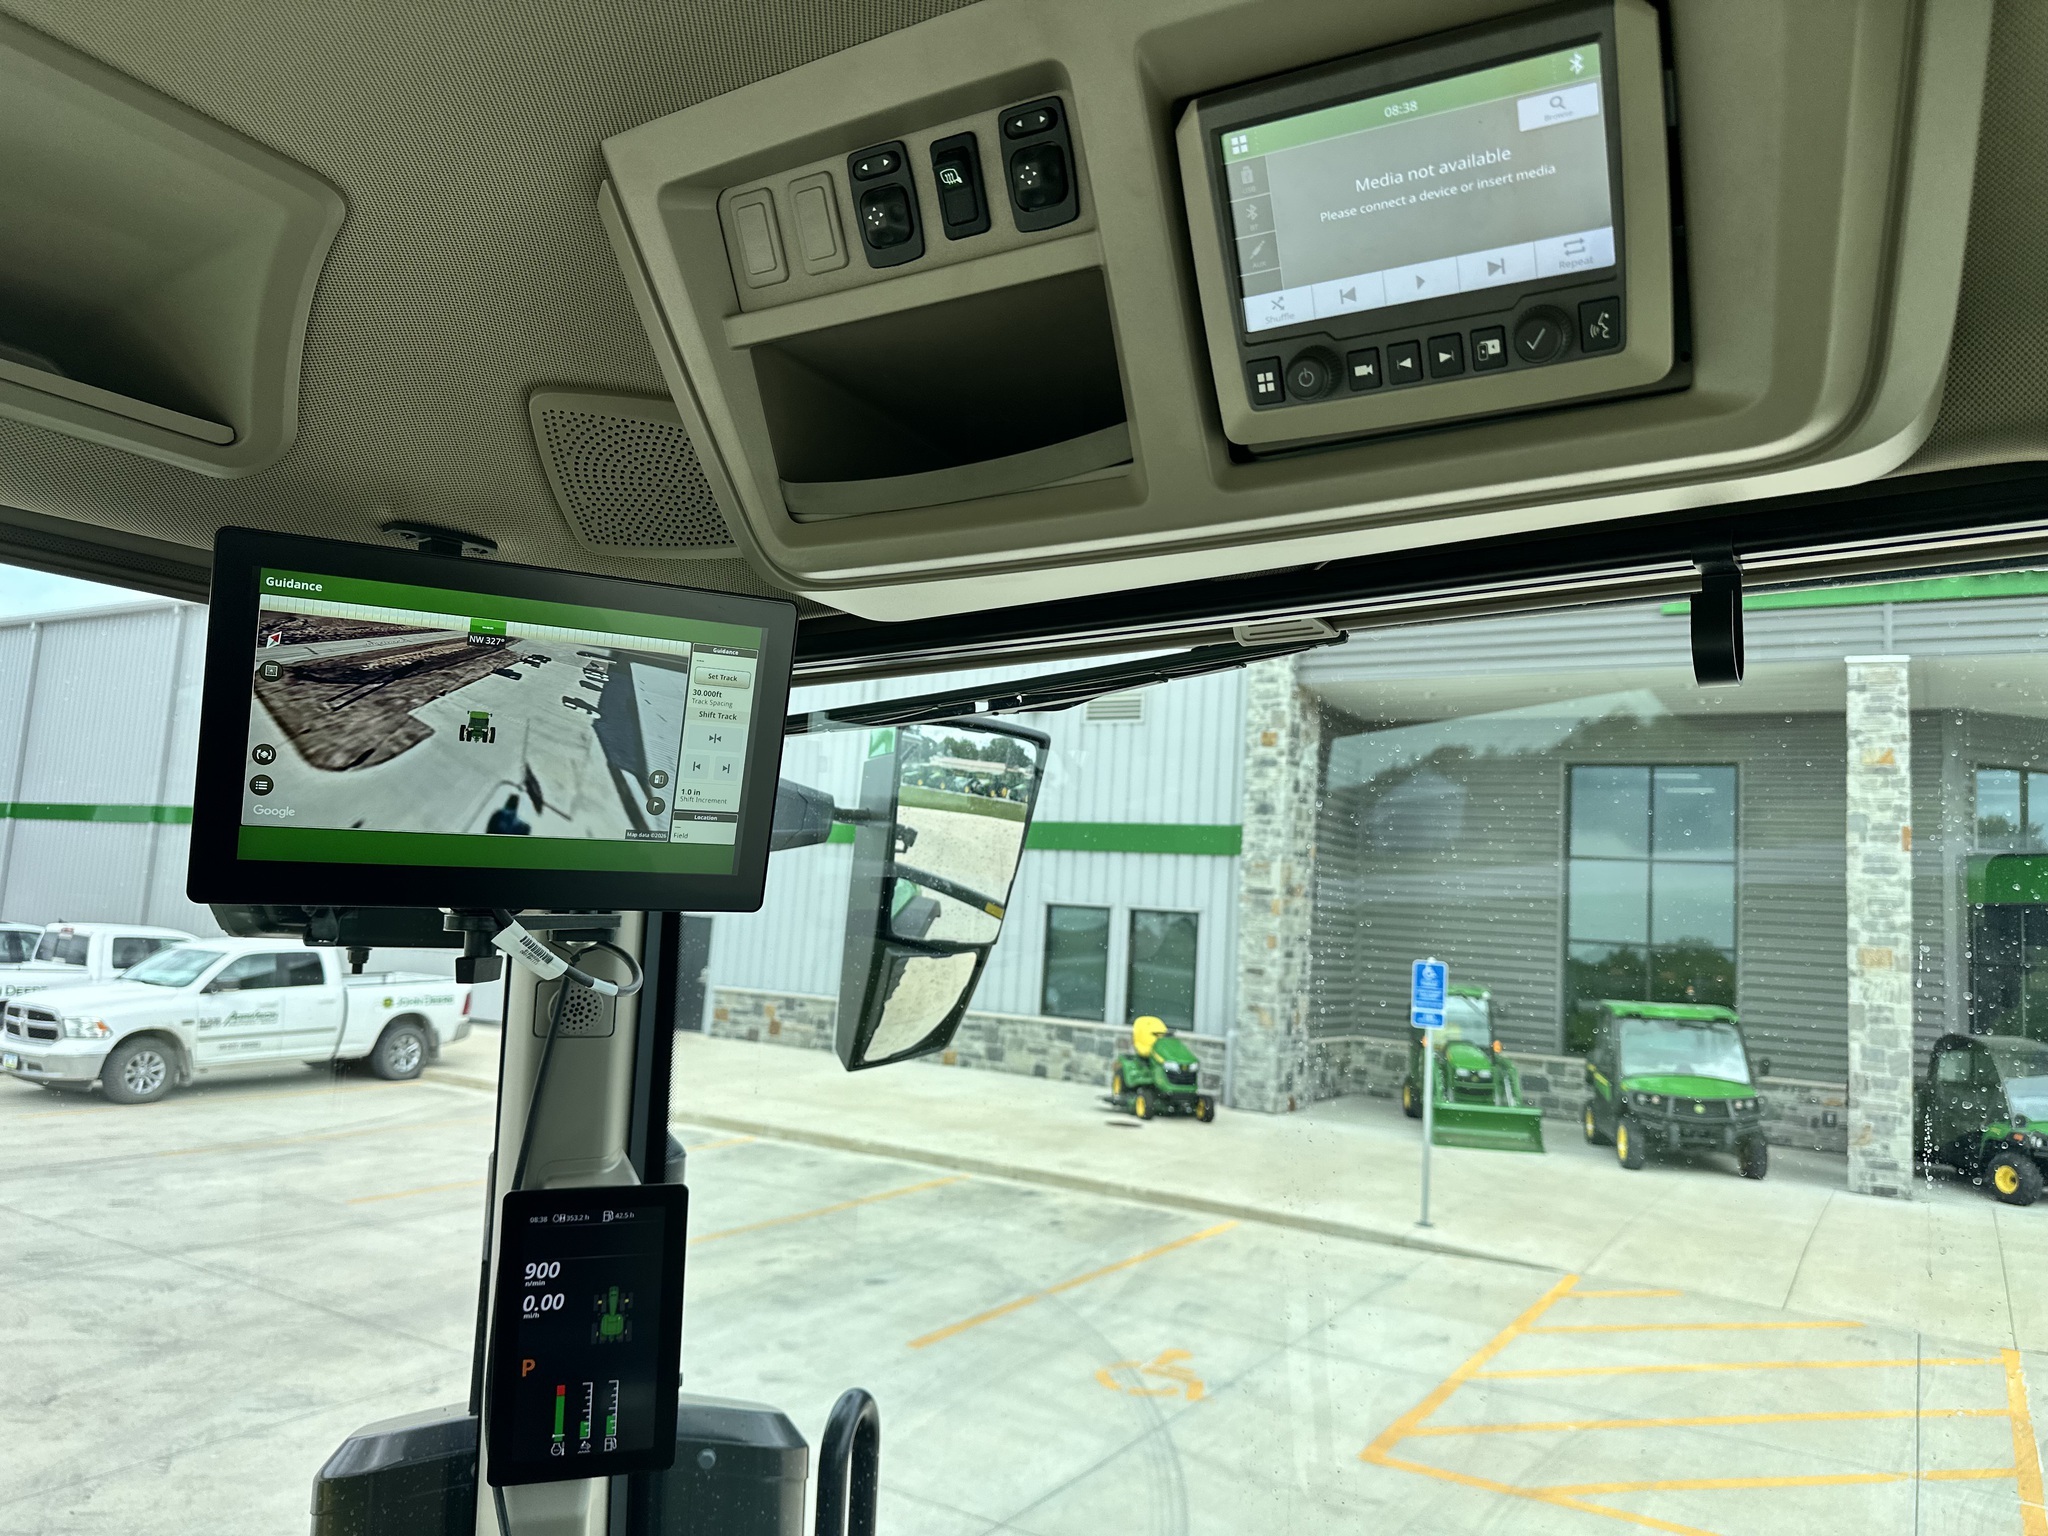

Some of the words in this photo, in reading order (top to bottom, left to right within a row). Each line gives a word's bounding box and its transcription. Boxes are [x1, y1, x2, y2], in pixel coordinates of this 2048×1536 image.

[1384, 100, 1418, 118] 08:38
[1355, 172, 1404, 192] Media
[1407, 164, 1435, 181] not
[1438, 147, 1512, 175] available
[1319, 207, 1358, 222] Please
[1359, 196, 1406, 214] connect
[1408, 195, 1417, 204] a
[1419, 189, 1458, 202] device
[1460, 182, 1474, 193] or
[1477, 173, 1513, 190] insert
[1516, 164, 1556, 181] media
[1559, 256, 1593, 269] Repeat
[1265, 311, 1295, 324] Shuffle
[265, 576, 323, 592] Guidance
[469, 635, 485, 644] NW
[485, 636, 506, 646] 327°
[712, 647, 739, 656] Guidance
[708, 672, 719, 680] Set
[720, 674, 738, 682] Track
[692, 688, 722, 698] 30.000ft
[692, 697, 709, 705] Track
[709, 699, 733, 709] Spacing
[699, 710, 716, 719] Shift
[718, 712, 738, 721] Track
[681, 788, 692, 796] 1.0
[693, 788, 701, 796] in
[680, 796, 695, 804] Shift
[695, 796, 728, 805] Increment
[253, 804, 296, 818] Google
[626, 831, 638, 839] Map
[614, 1212, 629, 1220] 42.5
[524, 1261, 561, 1280] 900
[522, 1293, 565, 1312] 0.00
[521, 1358, 536, 1377] P
